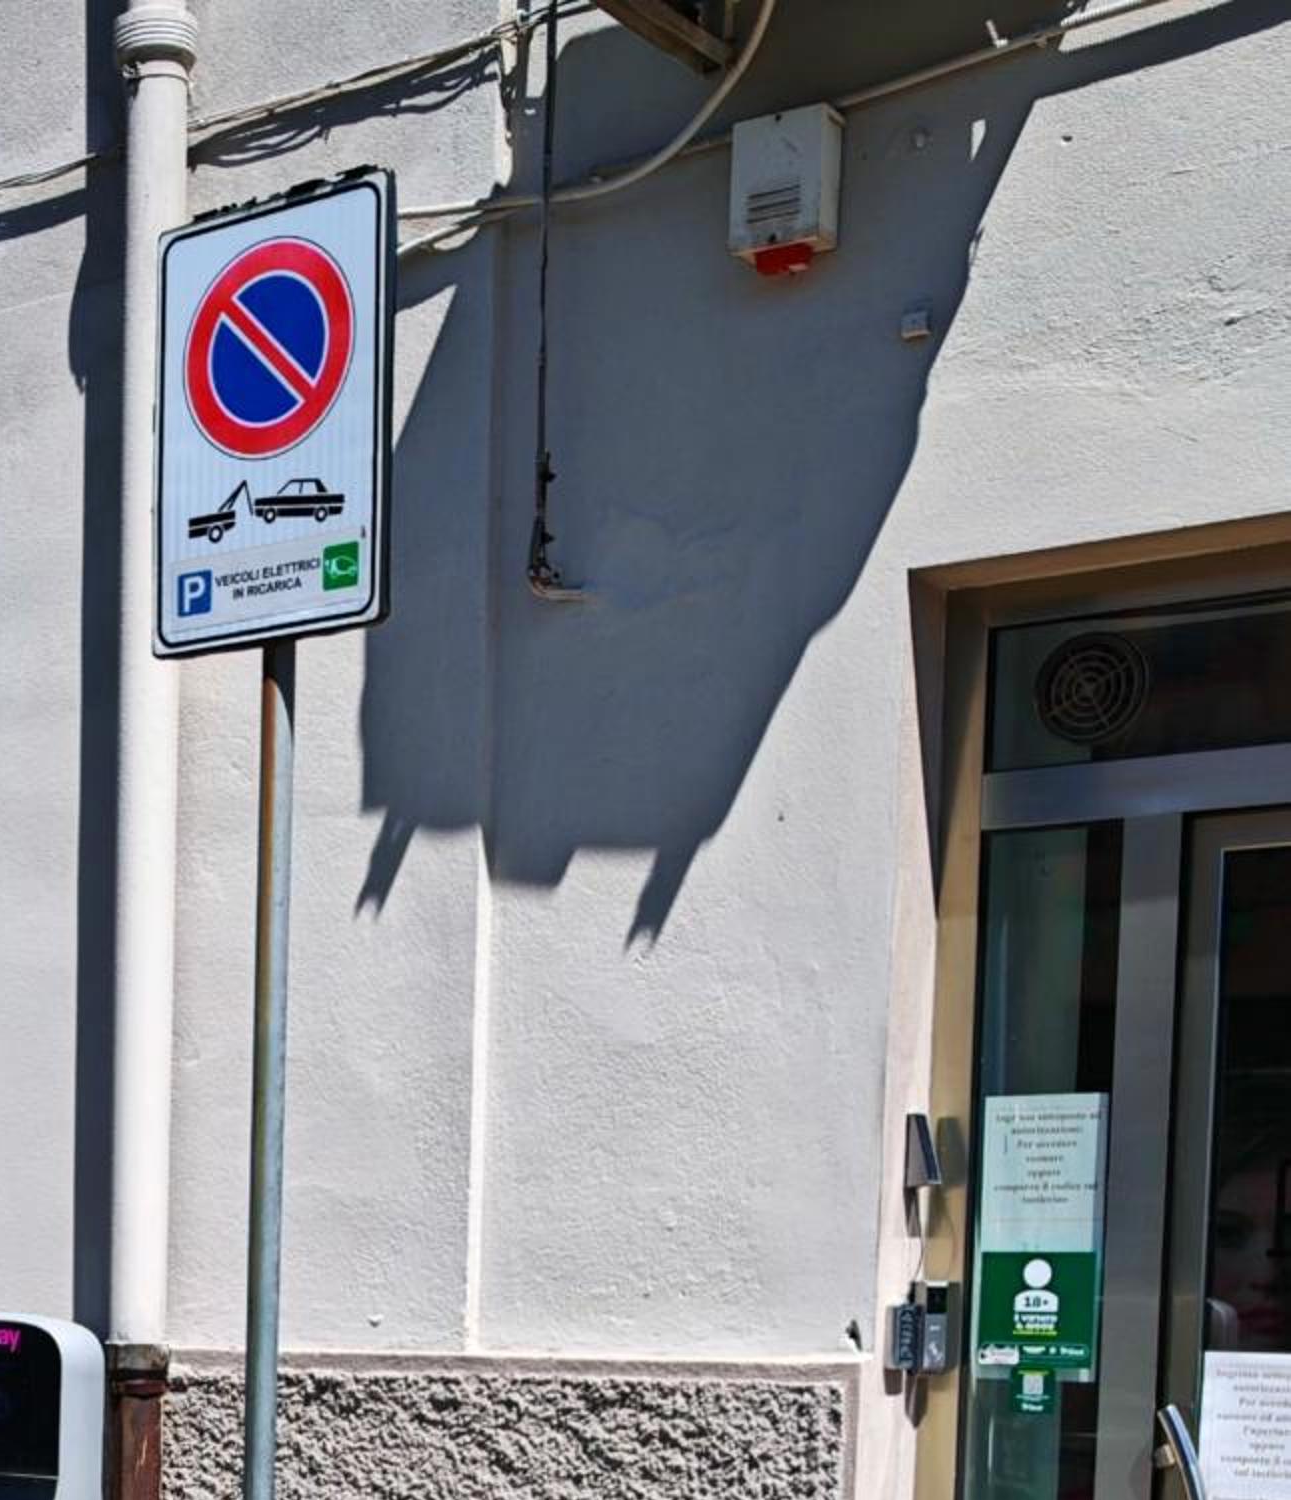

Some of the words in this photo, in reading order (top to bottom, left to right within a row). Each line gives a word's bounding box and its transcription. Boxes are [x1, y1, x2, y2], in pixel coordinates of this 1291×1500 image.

[214, 568, 259, 587] VEICOLI
[262, 557, 320, 579] ELETTRICI
[183, 575, 205, 613] P
[233, 587, 244, 599] IN
[246, 576, 302, 597] RICARICA
